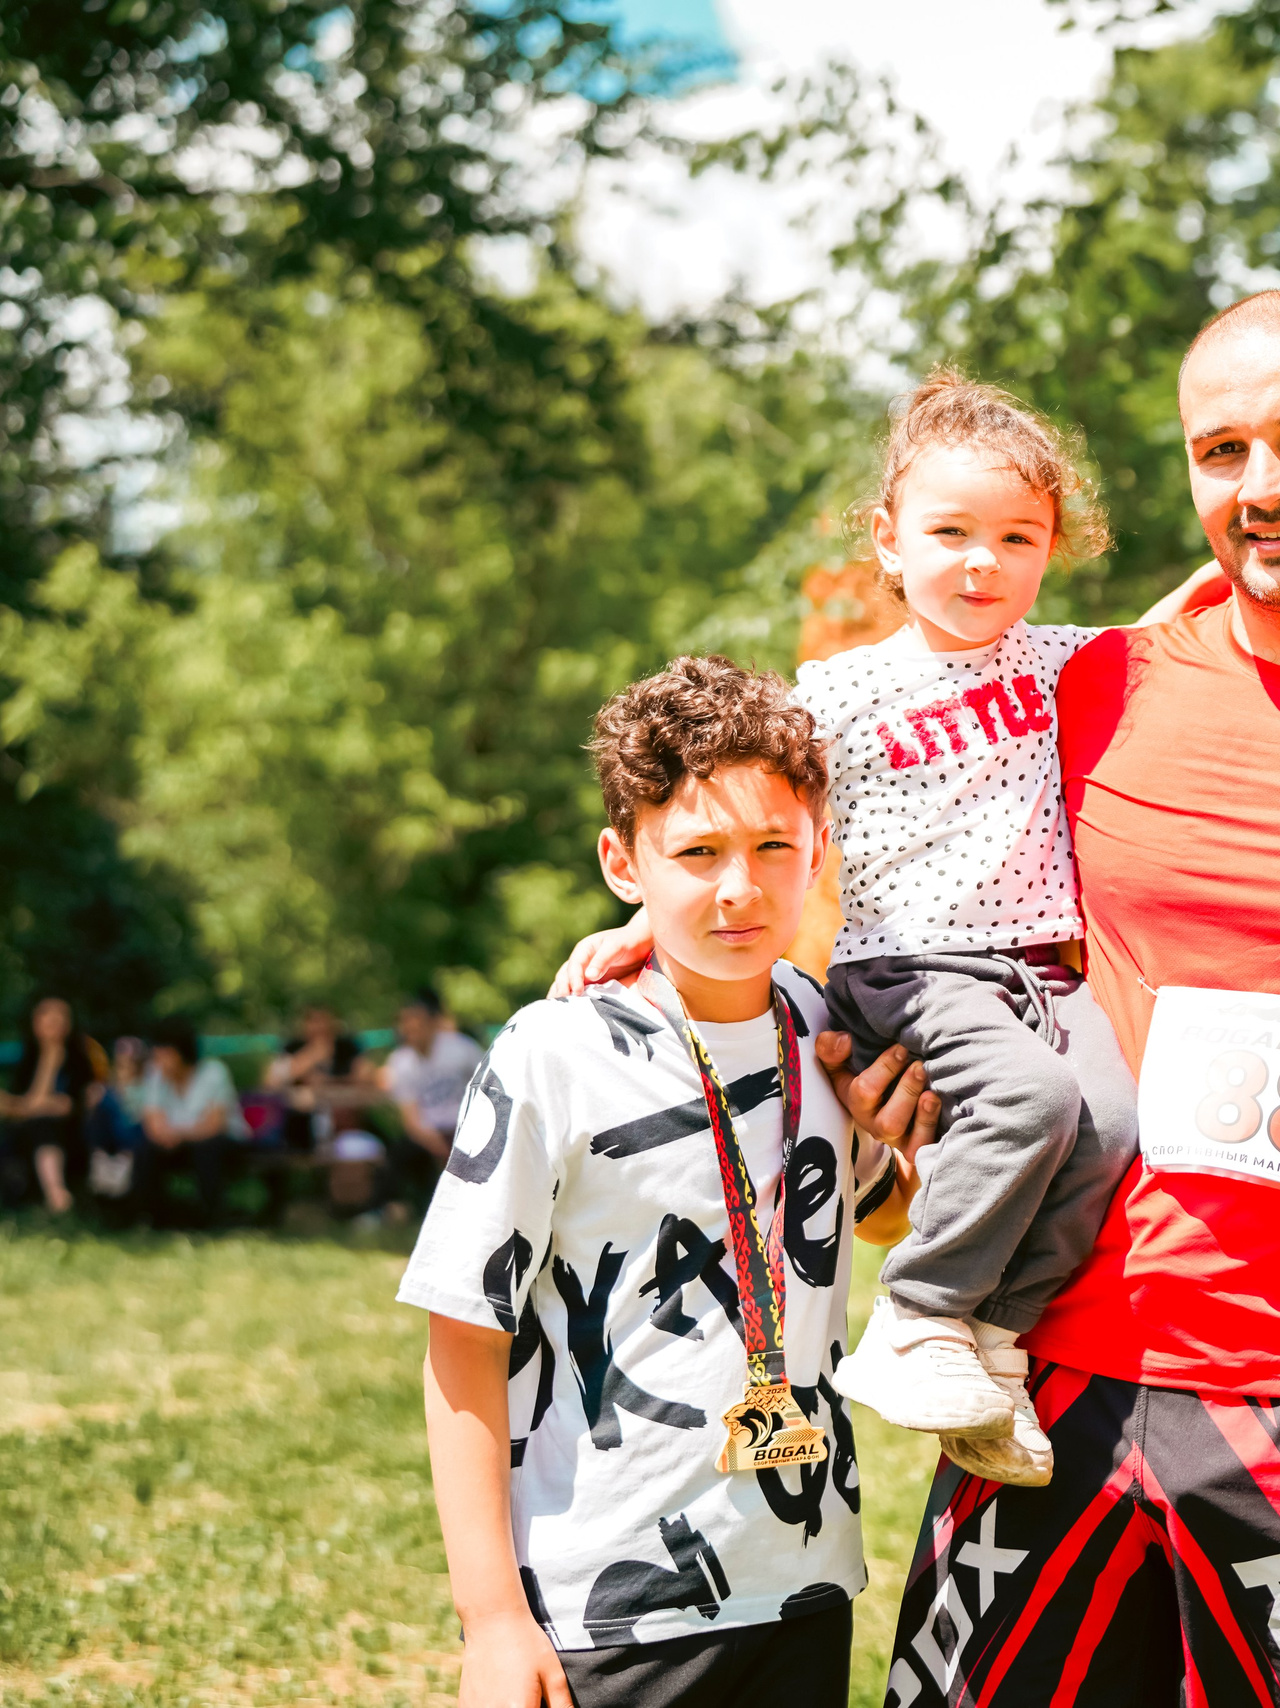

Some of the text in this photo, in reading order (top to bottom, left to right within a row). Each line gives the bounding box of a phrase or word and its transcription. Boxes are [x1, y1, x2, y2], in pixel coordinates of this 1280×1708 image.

[1151, 1145, 1249, 1165] СПОРТИВНЫЙ
[766, 1387, 787, 1395] 2025
[753, 1443, 819, 1461] BOGAL
